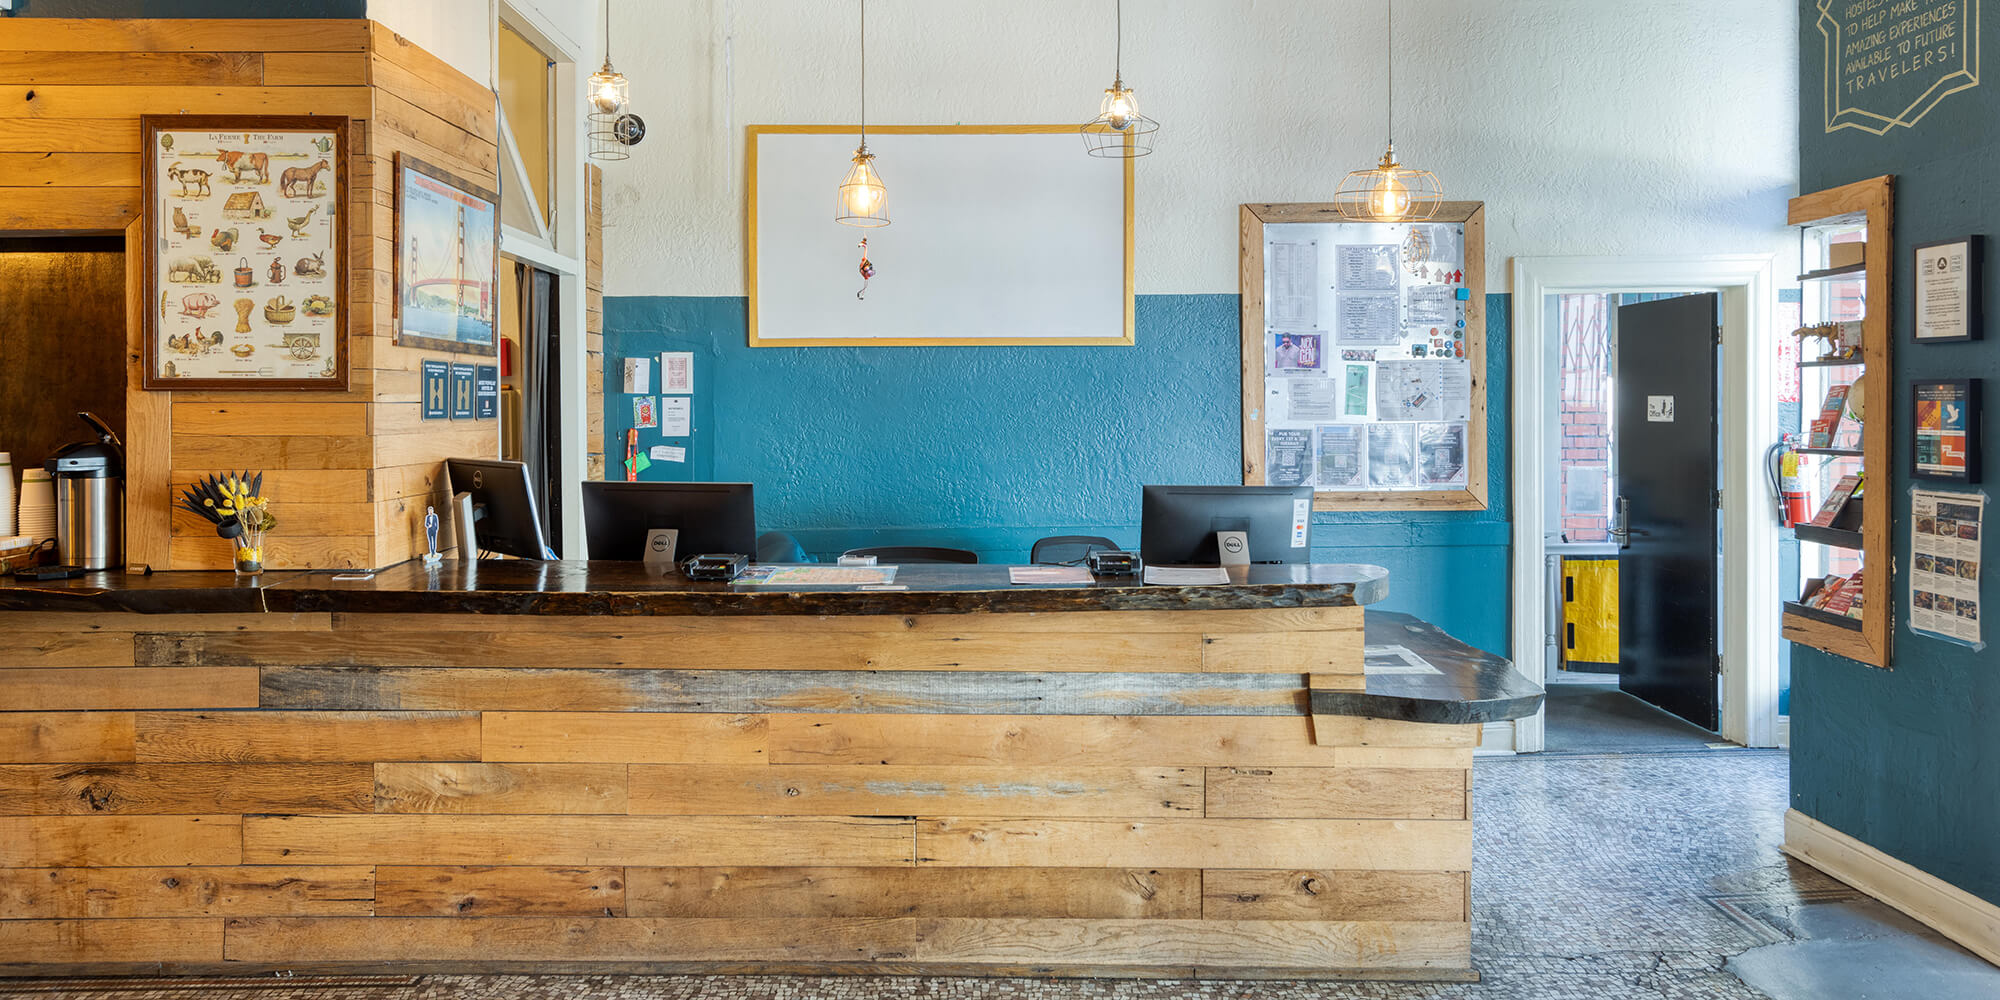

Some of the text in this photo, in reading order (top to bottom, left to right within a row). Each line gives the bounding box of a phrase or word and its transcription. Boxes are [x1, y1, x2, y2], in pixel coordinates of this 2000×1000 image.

[1845, 0, 1919, 37] TO HELP MAKE
[1845, 1, 1957, 58] AMAZING EXPERIENCES
[1845, 21, 1956, 76] AVAILABLE TO FUTURE
[1846, 42, 1956, 95] TRAVELERS!
